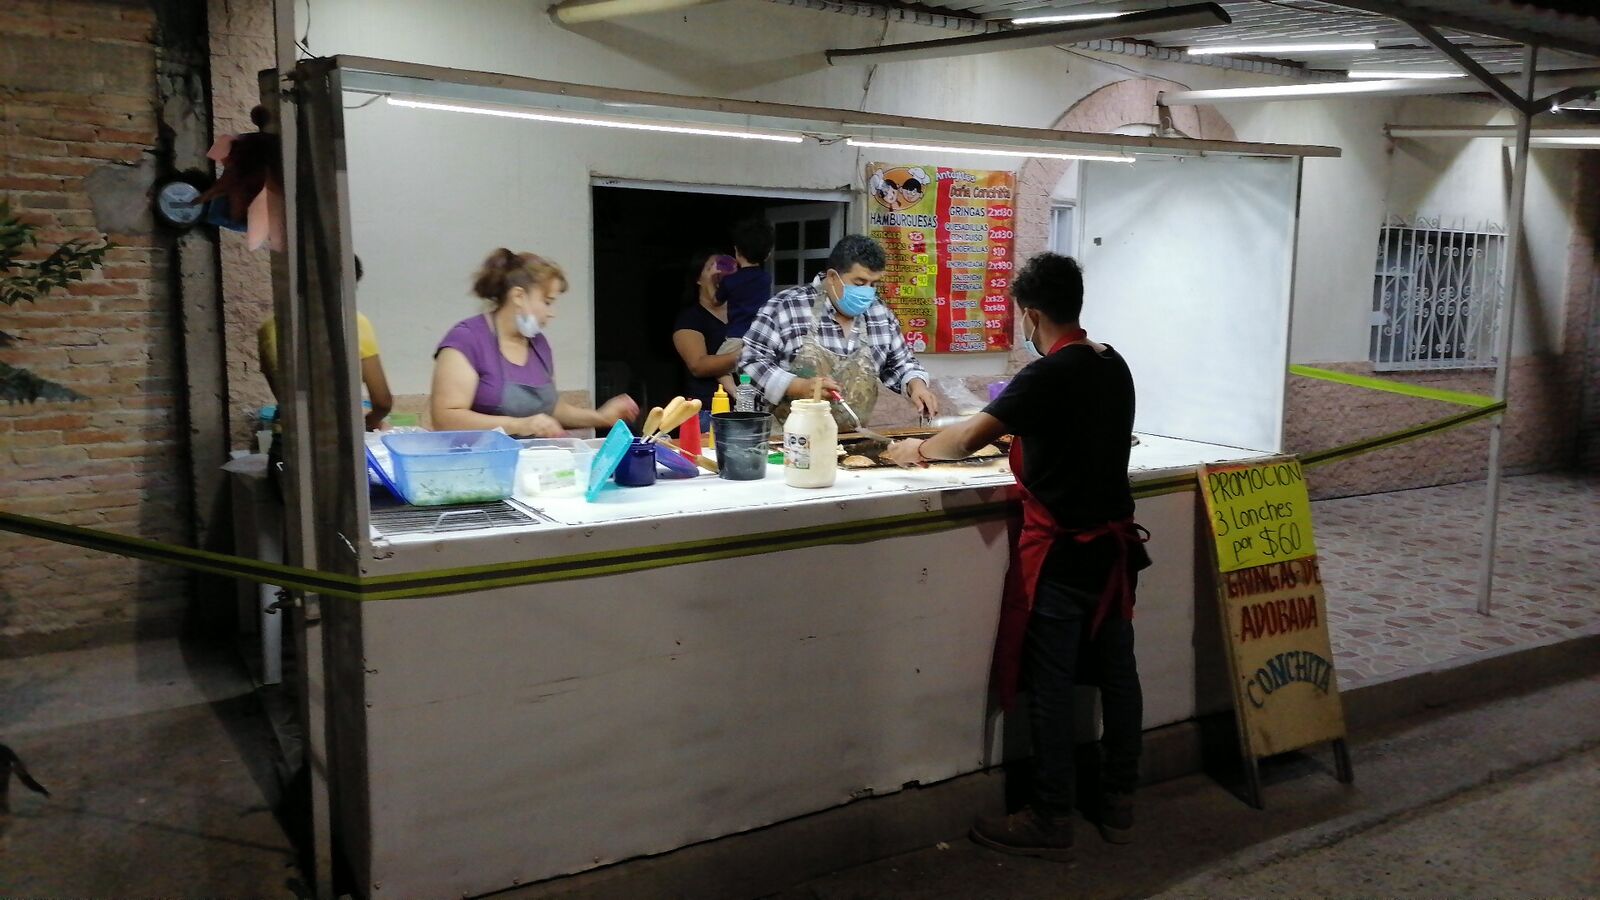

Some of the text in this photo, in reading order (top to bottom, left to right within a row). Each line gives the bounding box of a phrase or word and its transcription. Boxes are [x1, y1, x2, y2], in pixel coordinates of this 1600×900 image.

[950, 184, 971, 198] Doña
[870, 212, 938, 229] HAMBURGUESAS
[950, 206, 985, 217] GRINGAS
[945, 222, 988, 232] QUESADILLAS
[991, 279, 1006, 288] $25
[985, 320, 1001, 329] $15
[1208, 463, 1301, 504] PROMOCION
[1215, 510, 1230, 537] 3
[1232, 522, 1301, 562] por $60
[1227, 560, 1297, 598] GRINGAS
[1241, 595, 1318, 643] ADOBADA
[1247, 651, 1333, 709] CONCHITA
